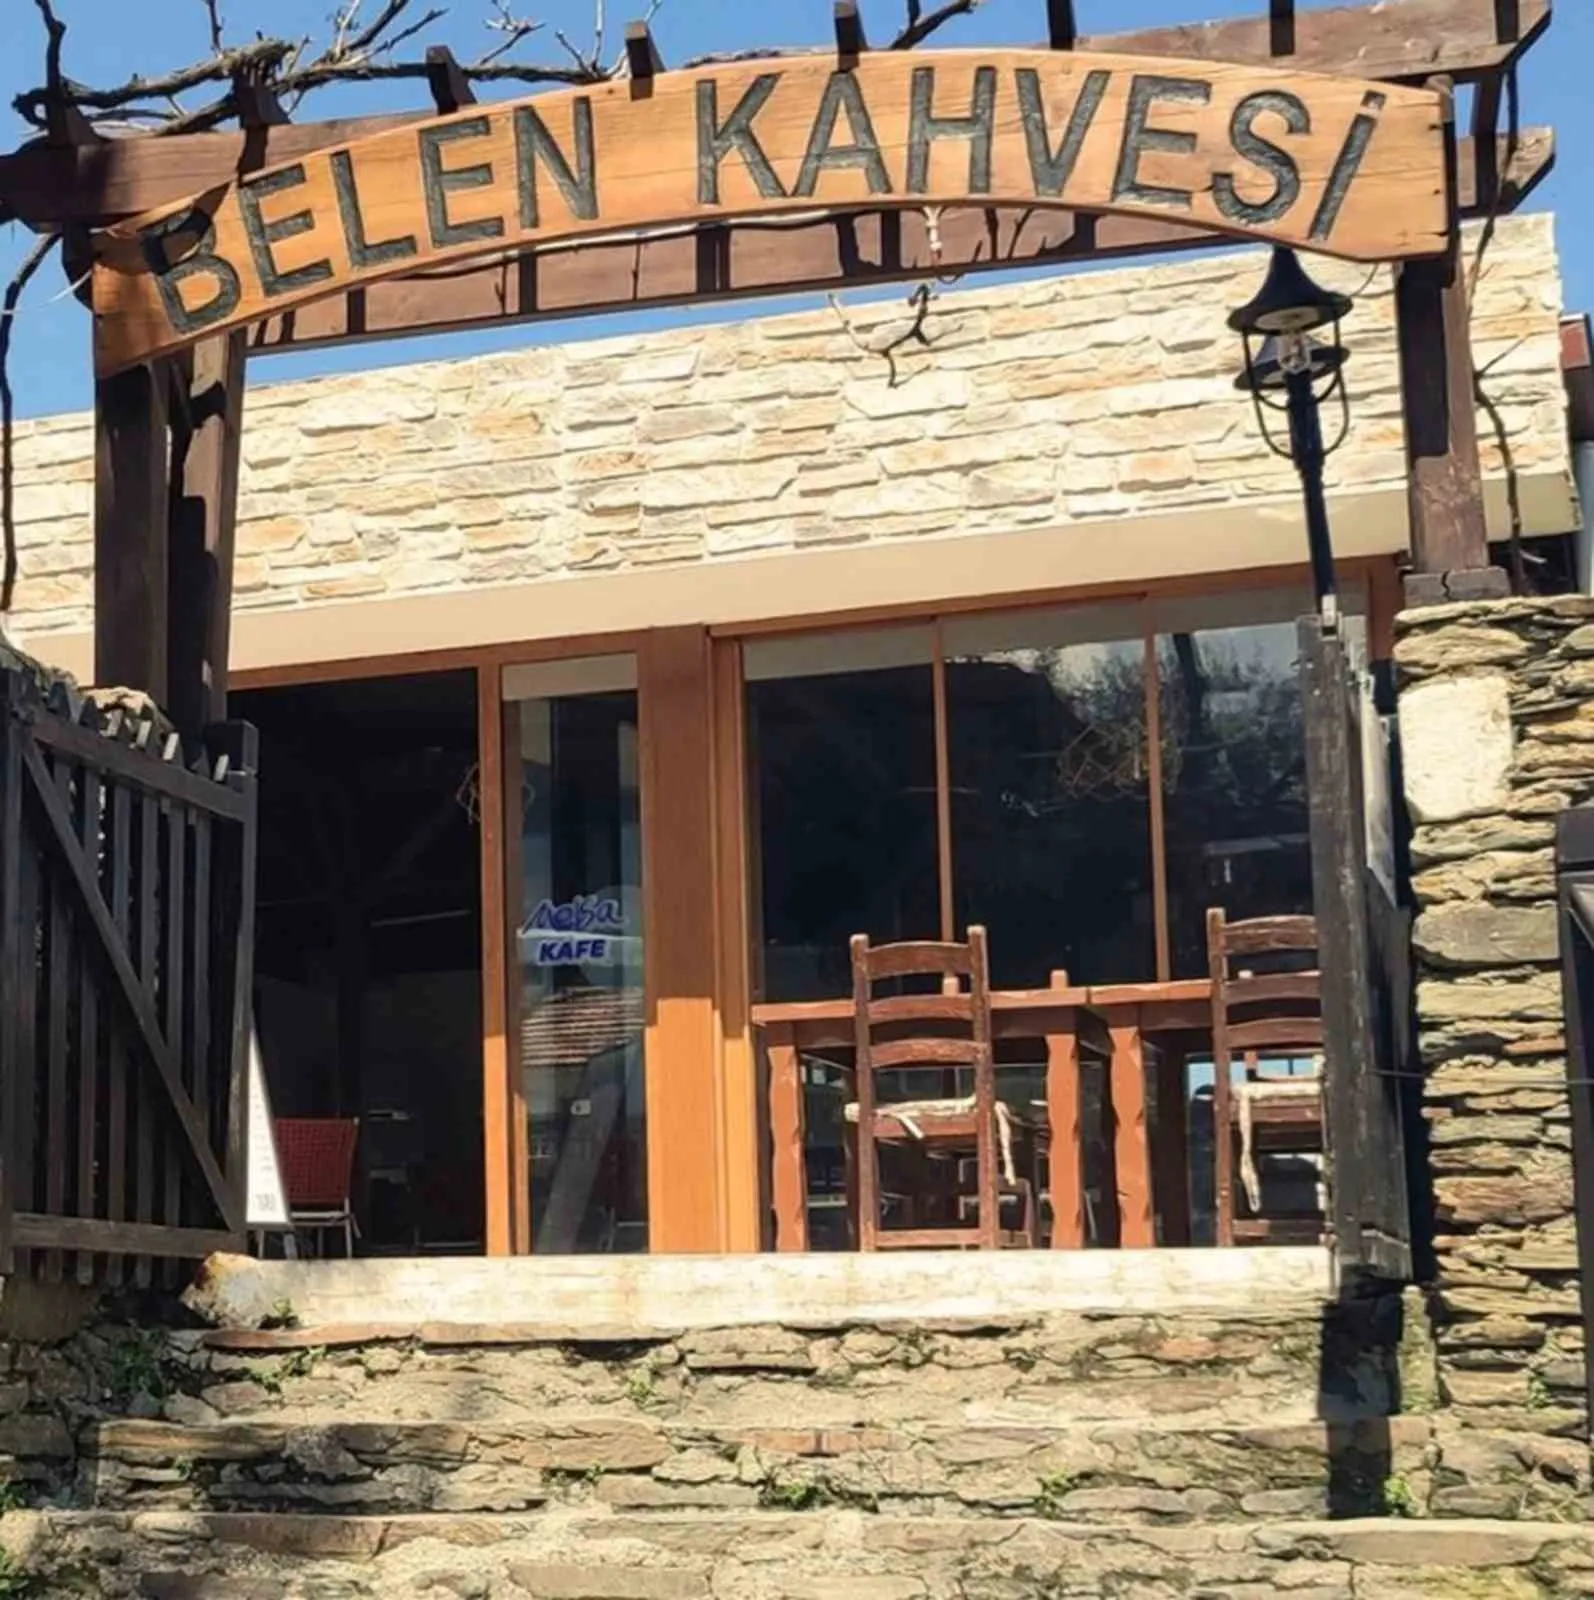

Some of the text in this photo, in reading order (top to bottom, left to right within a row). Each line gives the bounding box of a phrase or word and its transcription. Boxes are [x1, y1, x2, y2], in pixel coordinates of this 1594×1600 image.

[143, 66, 1386, 334] BELEN KAHVESİ
[538, 939, 607, 962] KAFE
